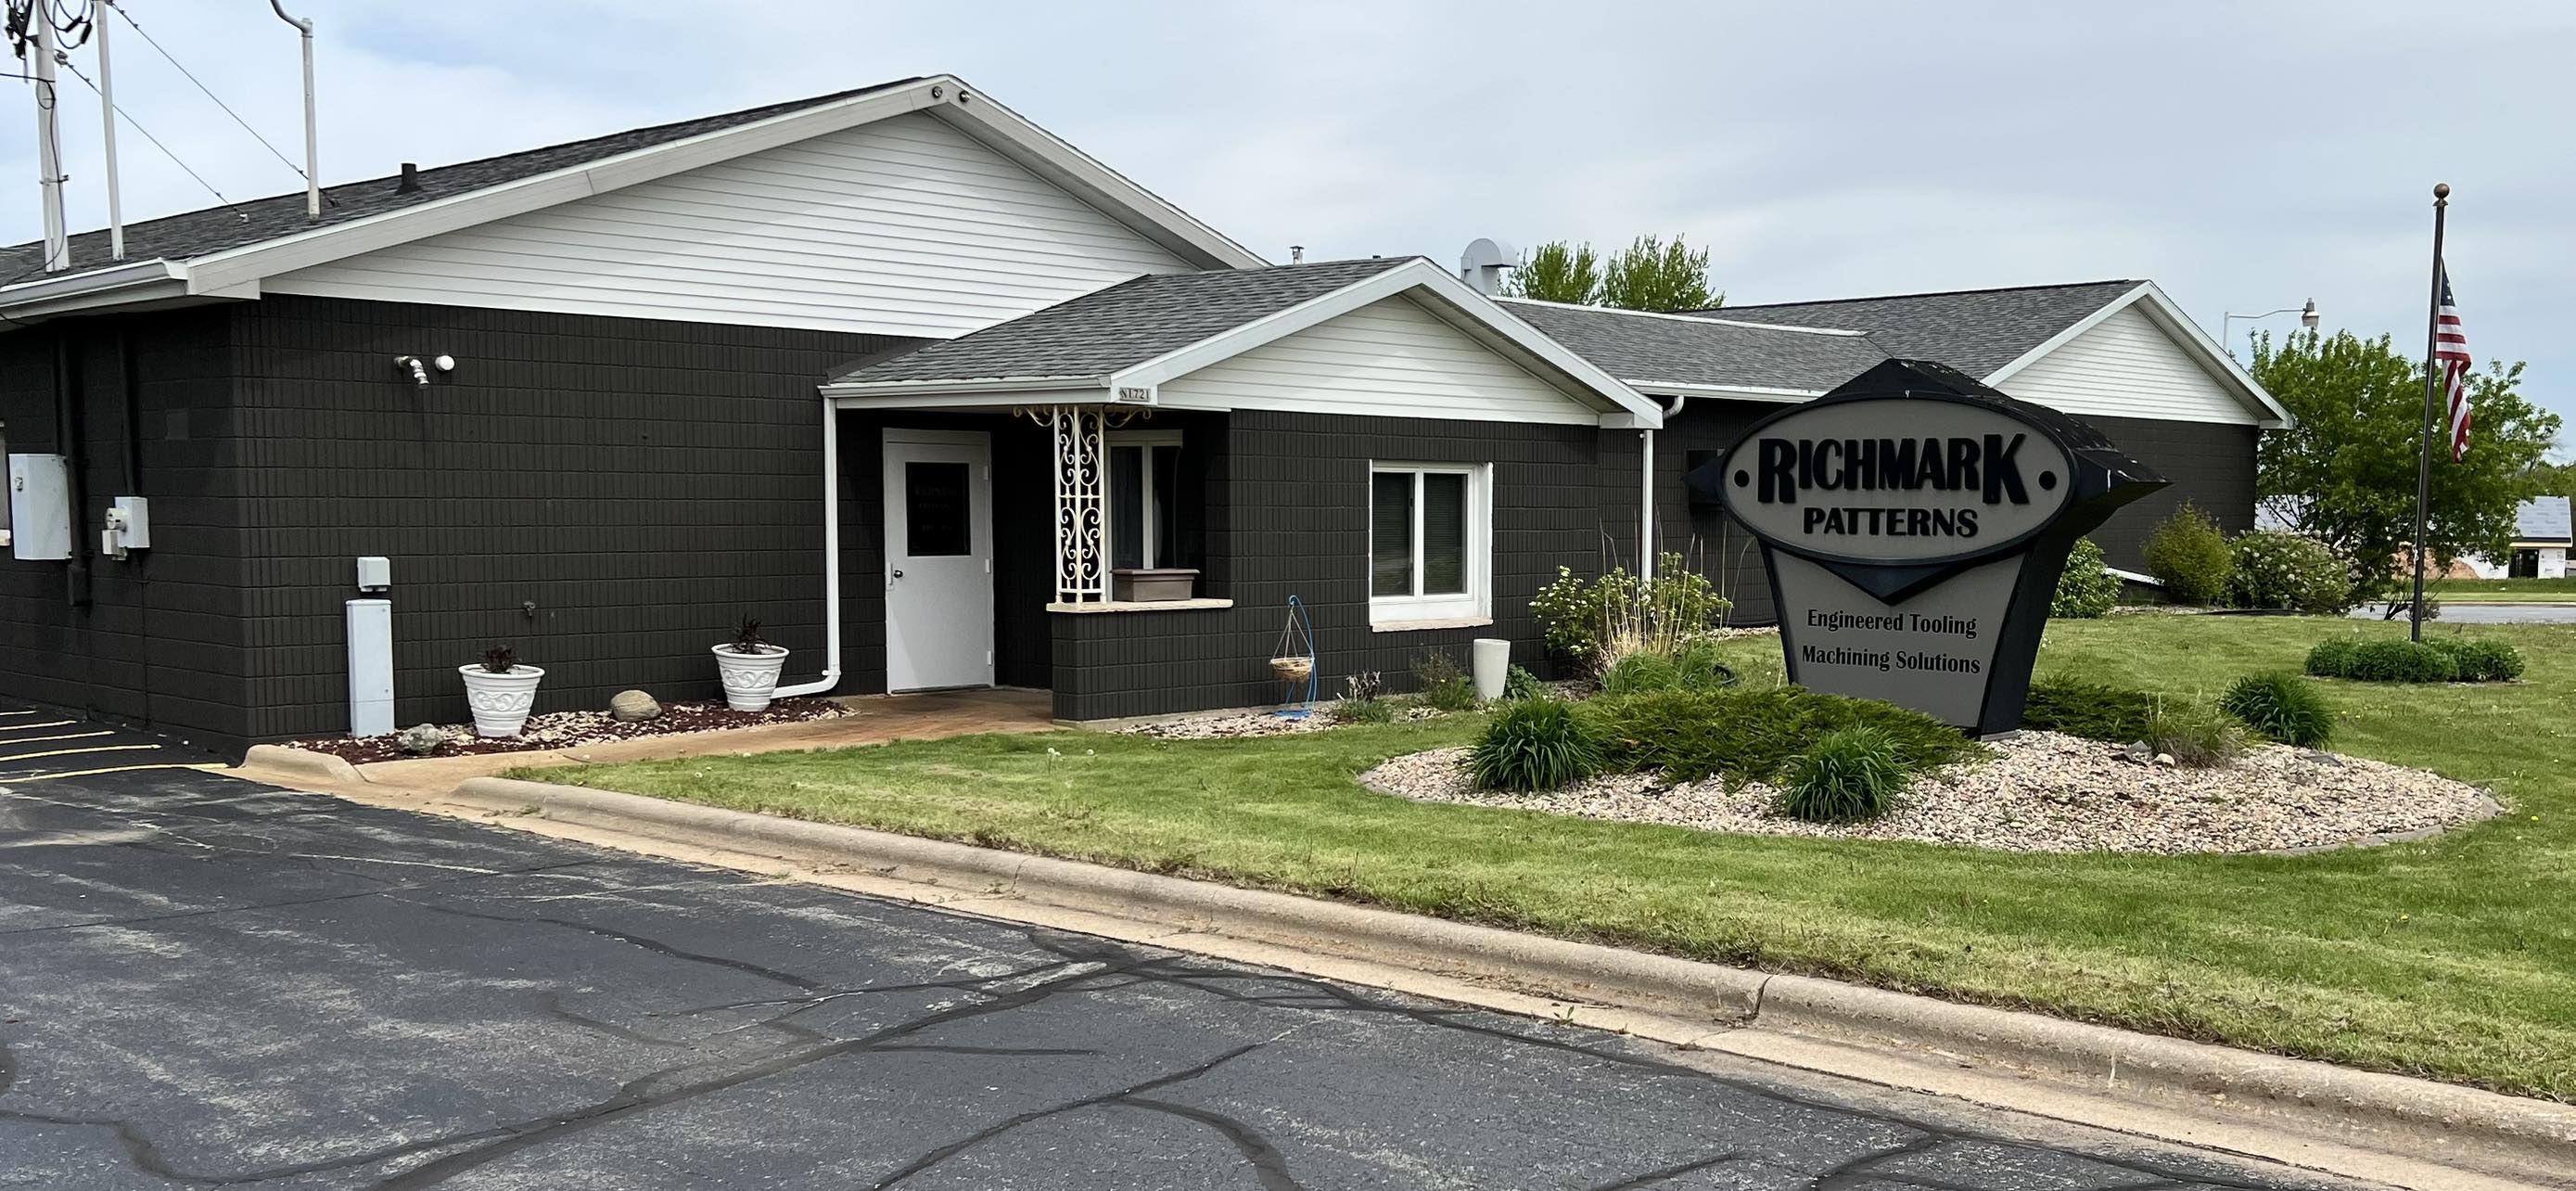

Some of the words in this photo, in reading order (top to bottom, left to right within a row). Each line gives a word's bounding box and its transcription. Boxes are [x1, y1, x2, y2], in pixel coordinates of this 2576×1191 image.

[1758, 433, 2030, 505] RICHMARK
[1804, 507, 1979, 538] PATTERNS
[1808, 609, 1904, 632] Engineered
[1909, 613, 1977, 639] Tooling
[1803, 645, 1891, 672] Machining
[1895, 651, 1981, 674] Solutions
